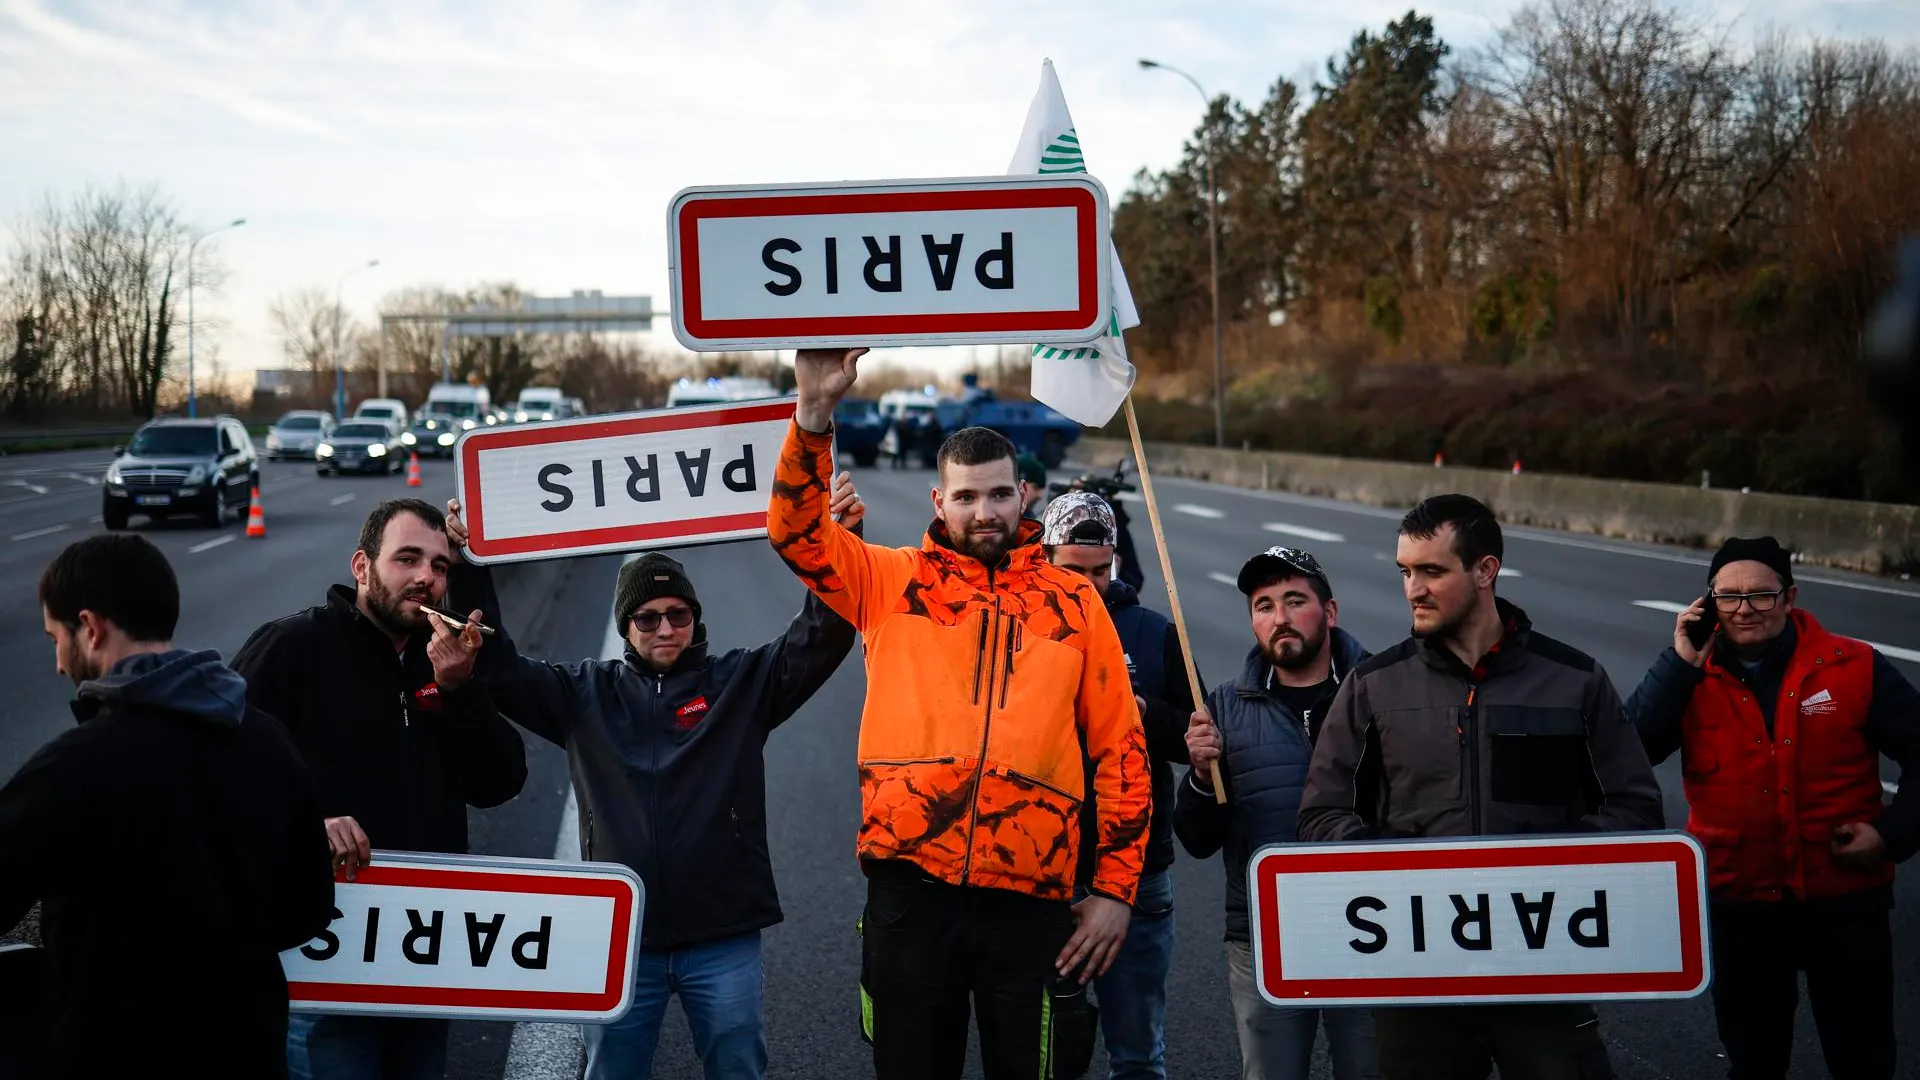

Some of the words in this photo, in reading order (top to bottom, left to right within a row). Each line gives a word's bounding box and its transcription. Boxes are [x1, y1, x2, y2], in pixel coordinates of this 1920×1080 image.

[762, 232, 1014, 296] PARIS
[538, 444, 757, 512] PARIS
[683, 702, 707, 715] Jeunes
[1346, 890, 1610, 954] PARIS
